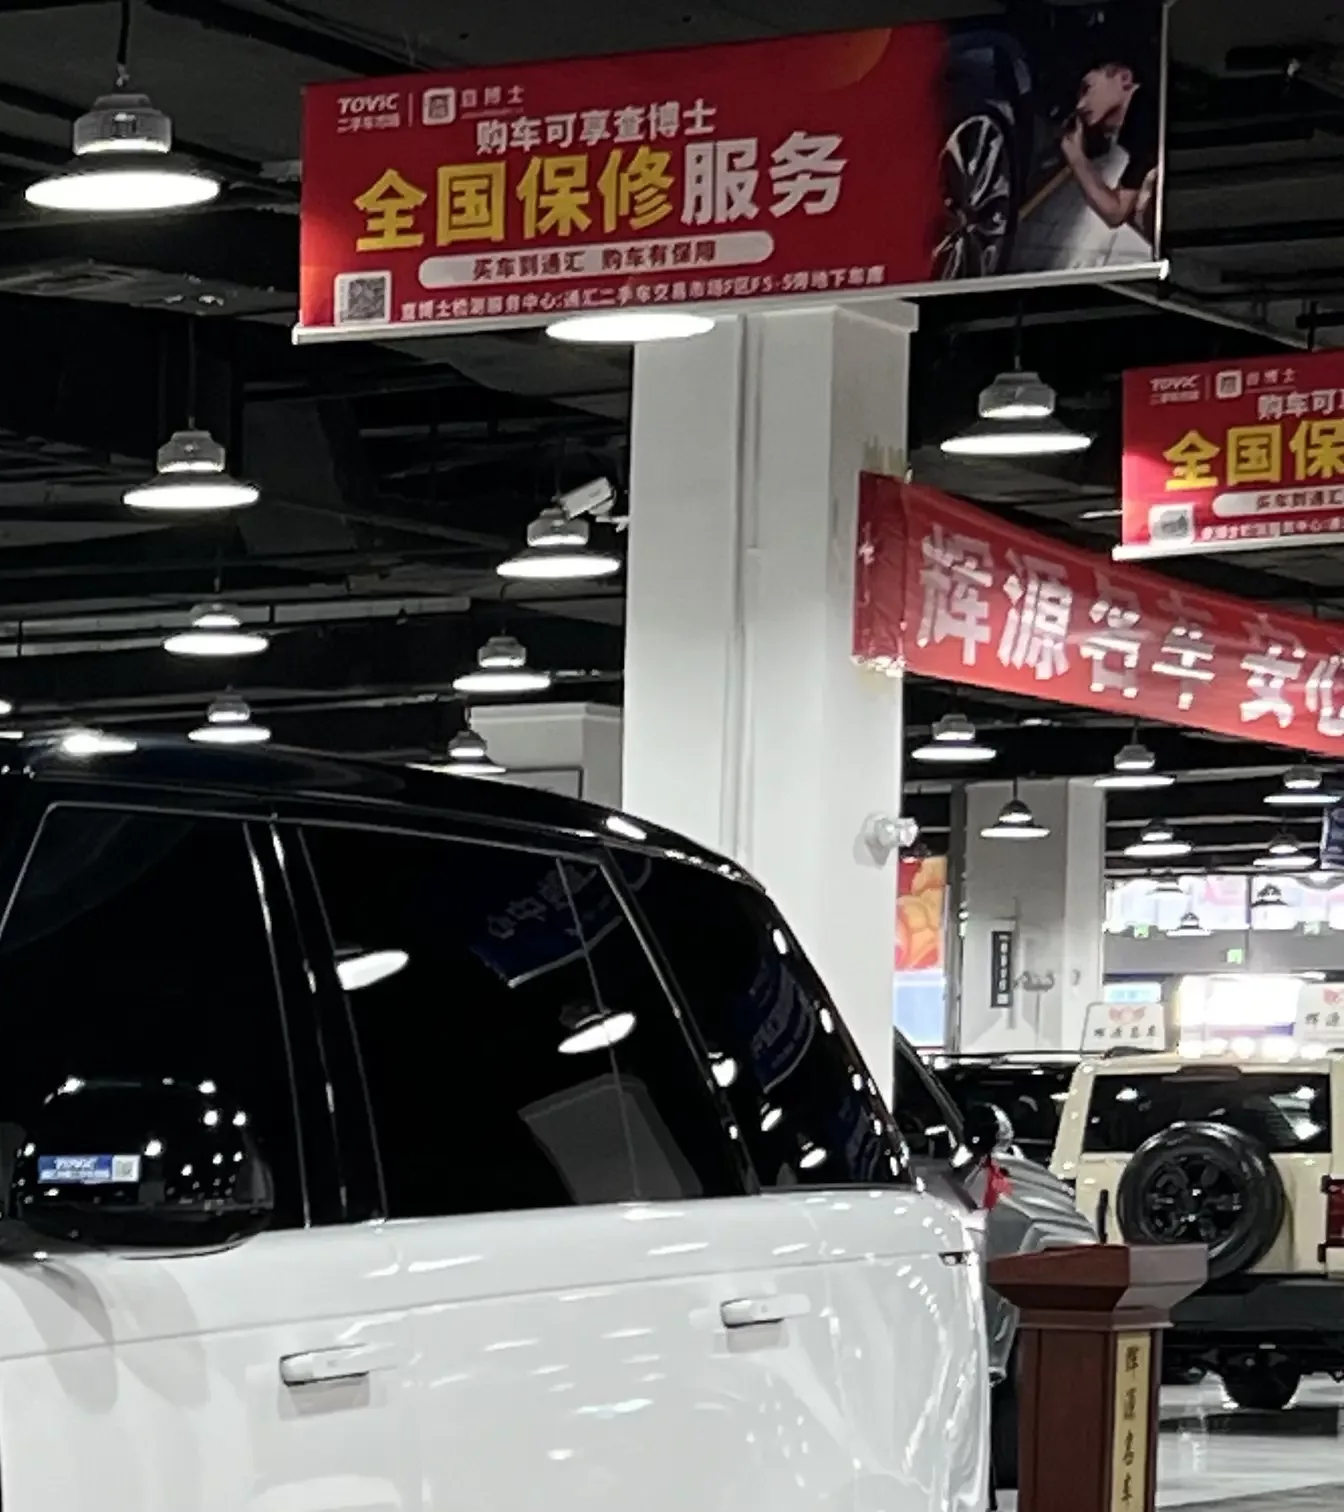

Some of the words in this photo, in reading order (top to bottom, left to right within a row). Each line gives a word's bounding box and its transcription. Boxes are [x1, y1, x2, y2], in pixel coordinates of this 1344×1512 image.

[476, 98, 717, 155] 购车可享查博士
[354, 130, 849, 252] 全国保修服务
